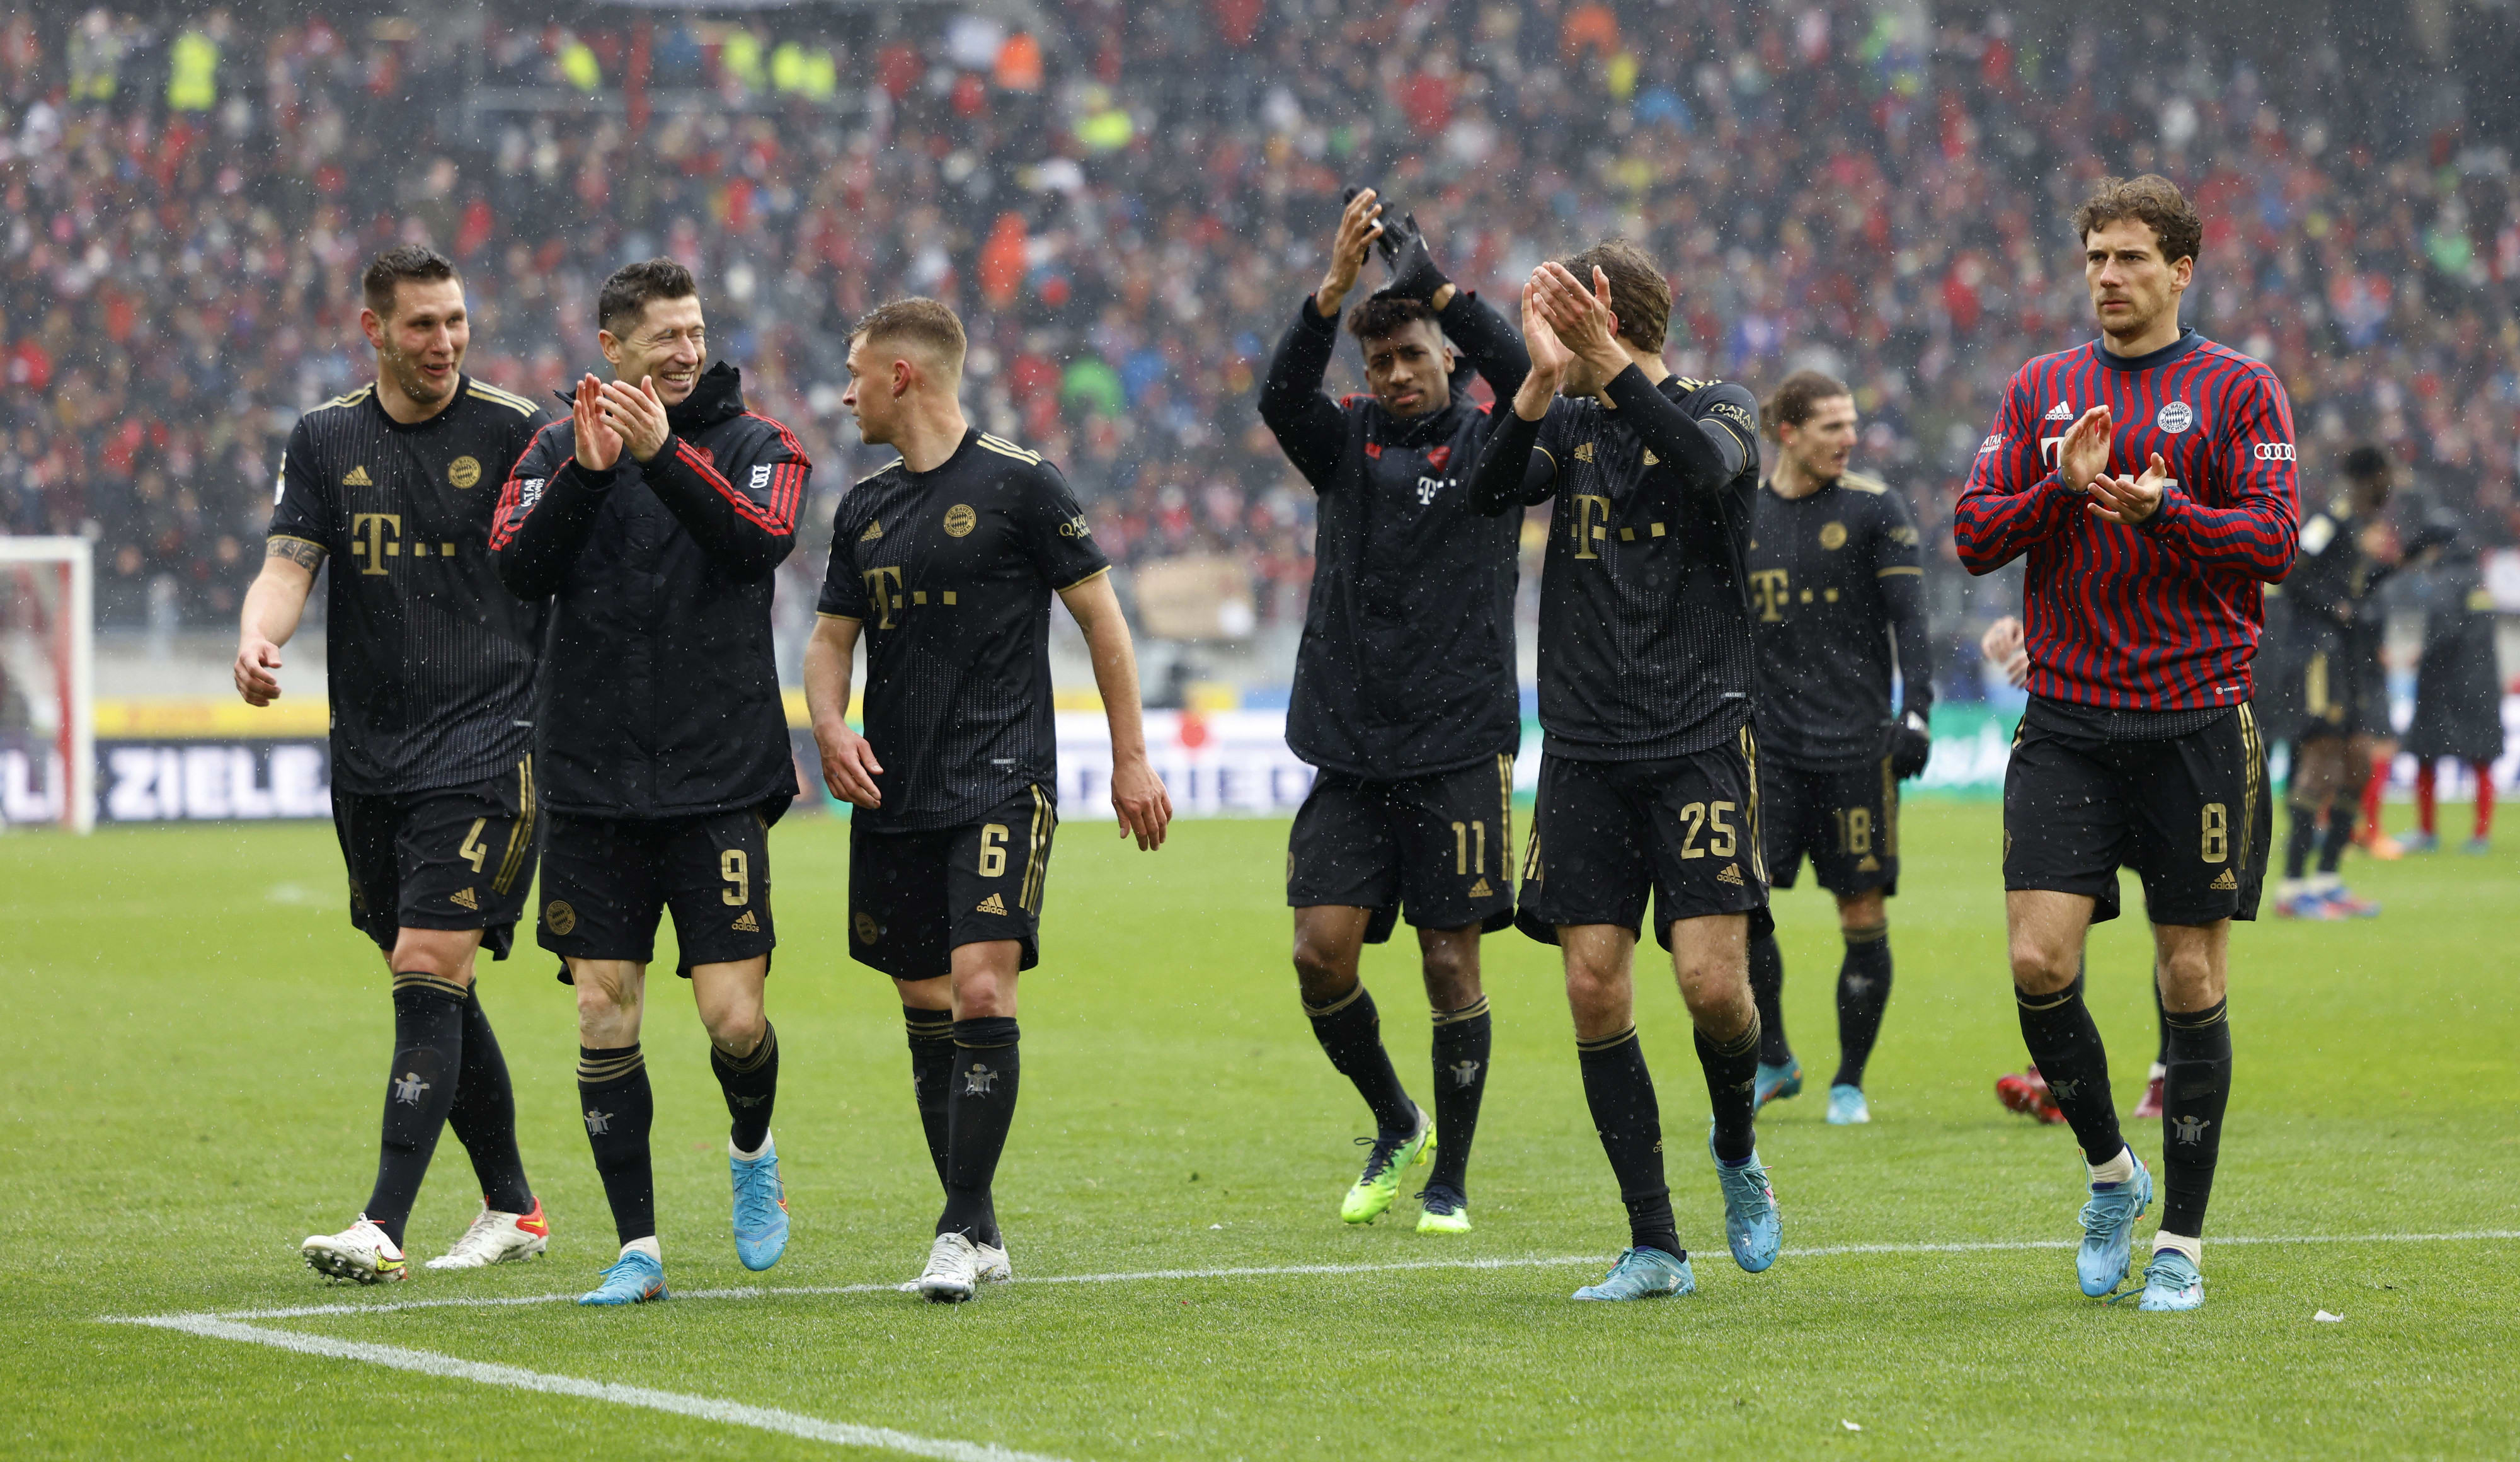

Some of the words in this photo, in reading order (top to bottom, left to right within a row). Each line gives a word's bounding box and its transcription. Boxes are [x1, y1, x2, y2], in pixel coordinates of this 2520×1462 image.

[2045, 413, 2073, 421] adidas
[2171, 404, 2190, 417] BAYERN
[1981, 433, 2002, 447] ATAR
[954, 507, 973, 520] BAYERN
[1680, 800, 1737, 860] 25
[1834, 807, 1871, 855] 18
[2202, 802, 2228, 863] 8
[459, 817, 488, 873] 4
[978, 824, 1009, 877] 6
[1452, 820, 1485, 875] 11
[721, 849, 749, 906] 9
[1717, 875, 1744, 886] adidas
[450, 895, 478, 910] adidas
[976, 905, 1008, 916] adidas
[731, 923, 760, 933] adidas
